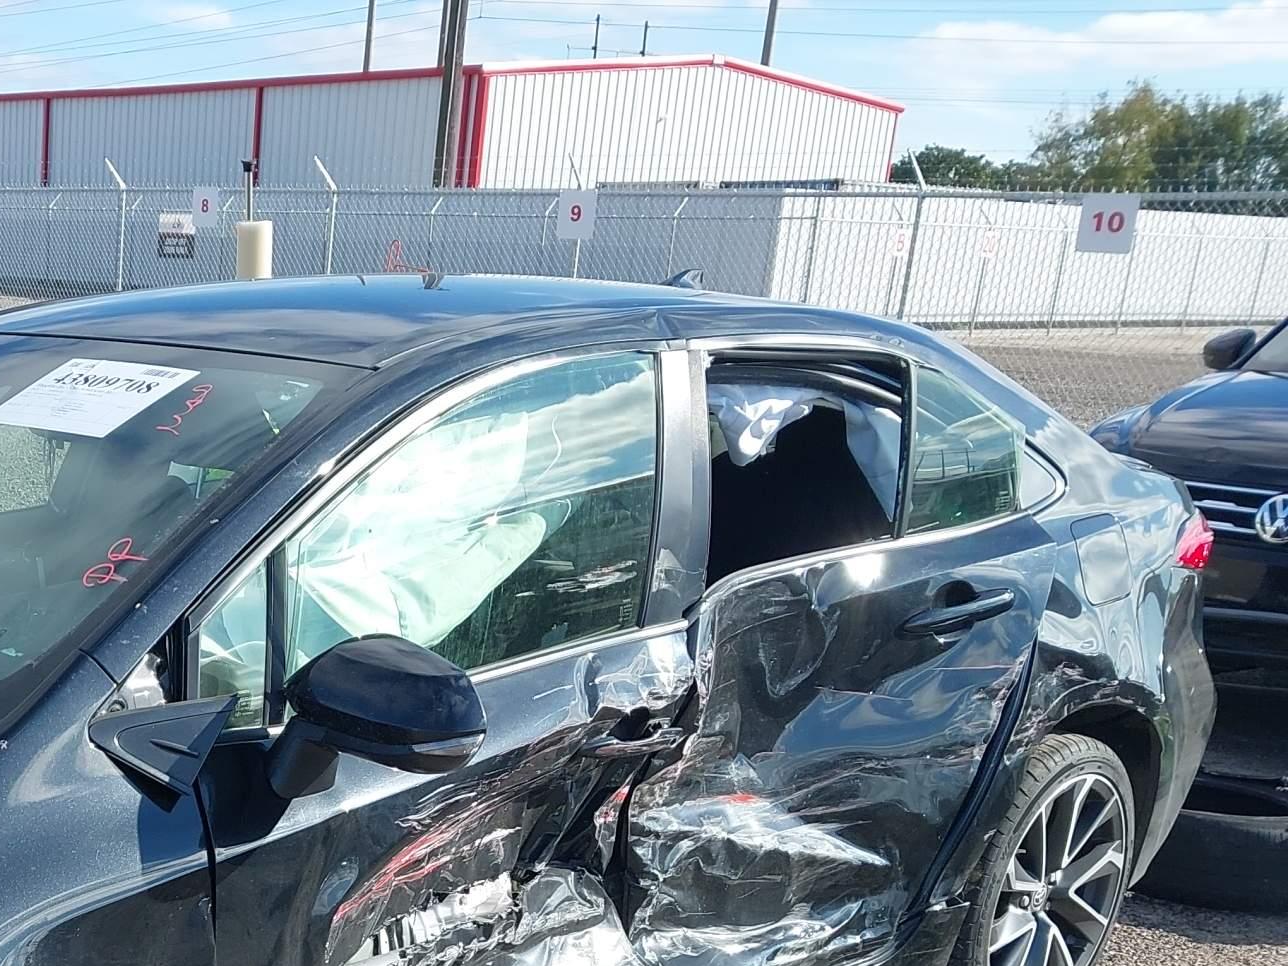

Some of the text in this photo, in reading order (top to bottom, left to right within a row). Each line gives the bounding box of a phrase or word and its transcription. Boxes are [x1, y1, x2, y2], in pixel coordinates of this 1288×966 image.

[201, 199, 208, 213] 8
[570, 205, 581, 222] 9
[1093, 211, 1125, 232] 10
[53, 371, 160, 394] 43809708
